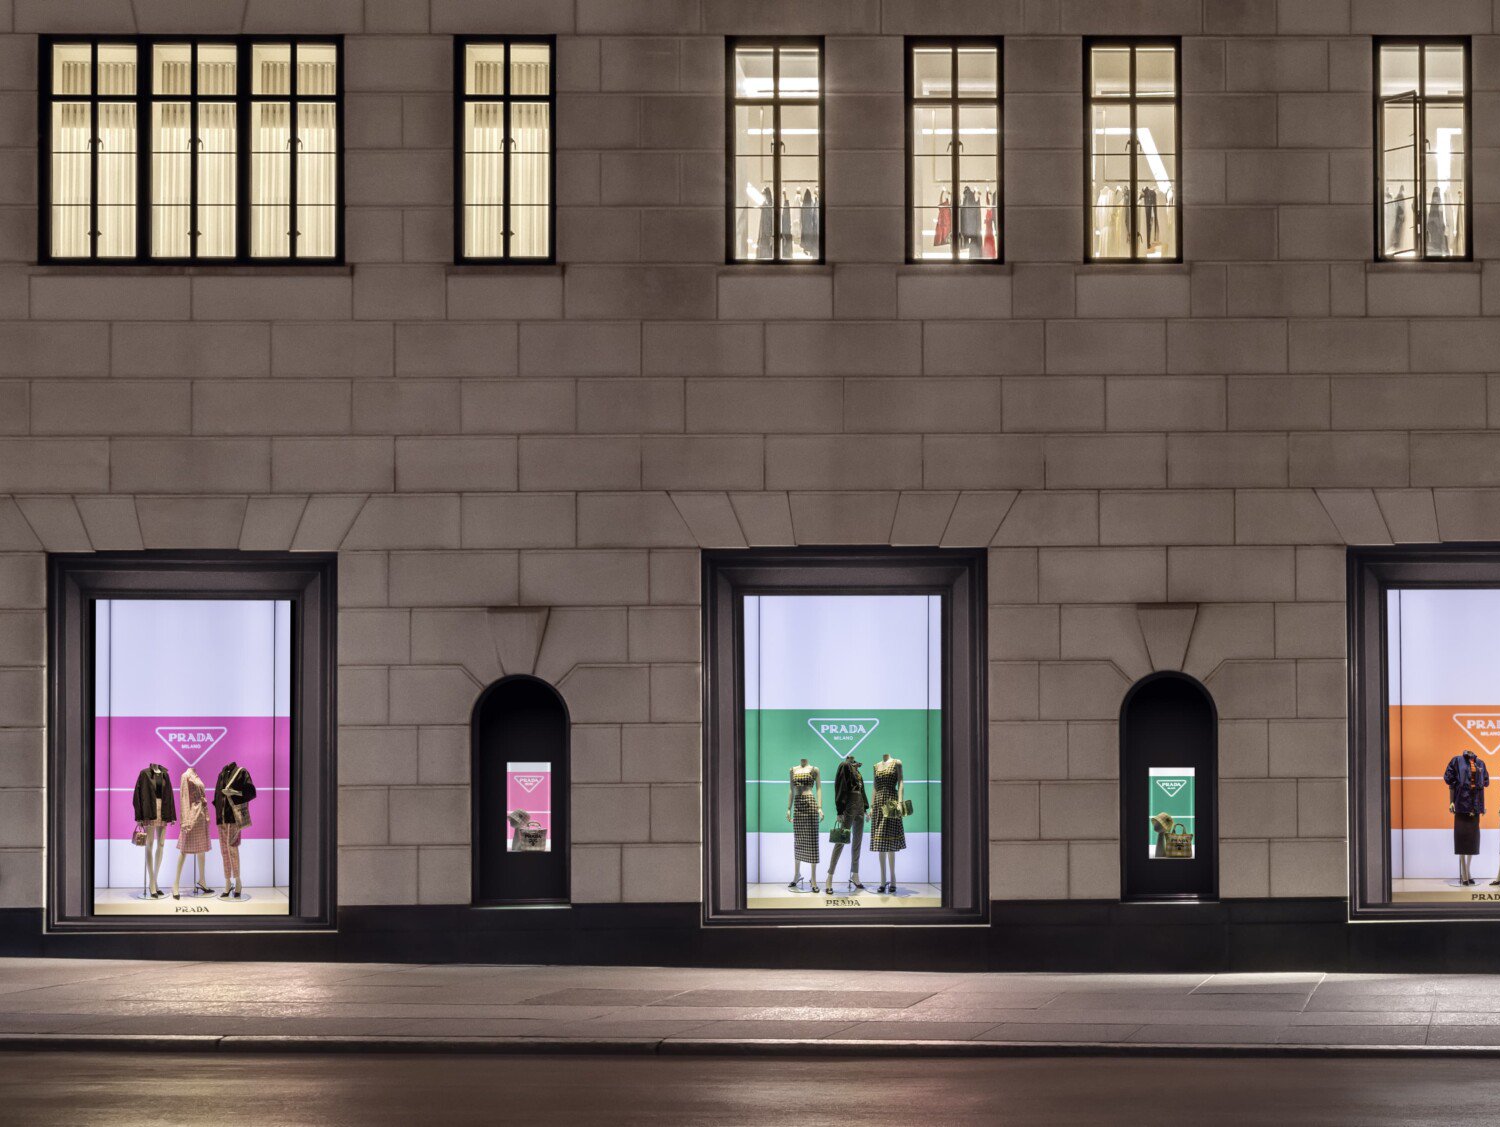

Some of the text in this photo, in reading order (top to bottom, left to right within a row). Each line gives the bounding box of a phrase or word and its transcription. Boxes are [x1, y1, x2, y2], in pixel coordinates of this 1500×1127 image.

[820, 724, 867, 734] PRADA
[168, 733, 215, 742] PRADA
[826, 899, 861, 907] PRADA
[175, 905, 210, 913] PRADA
